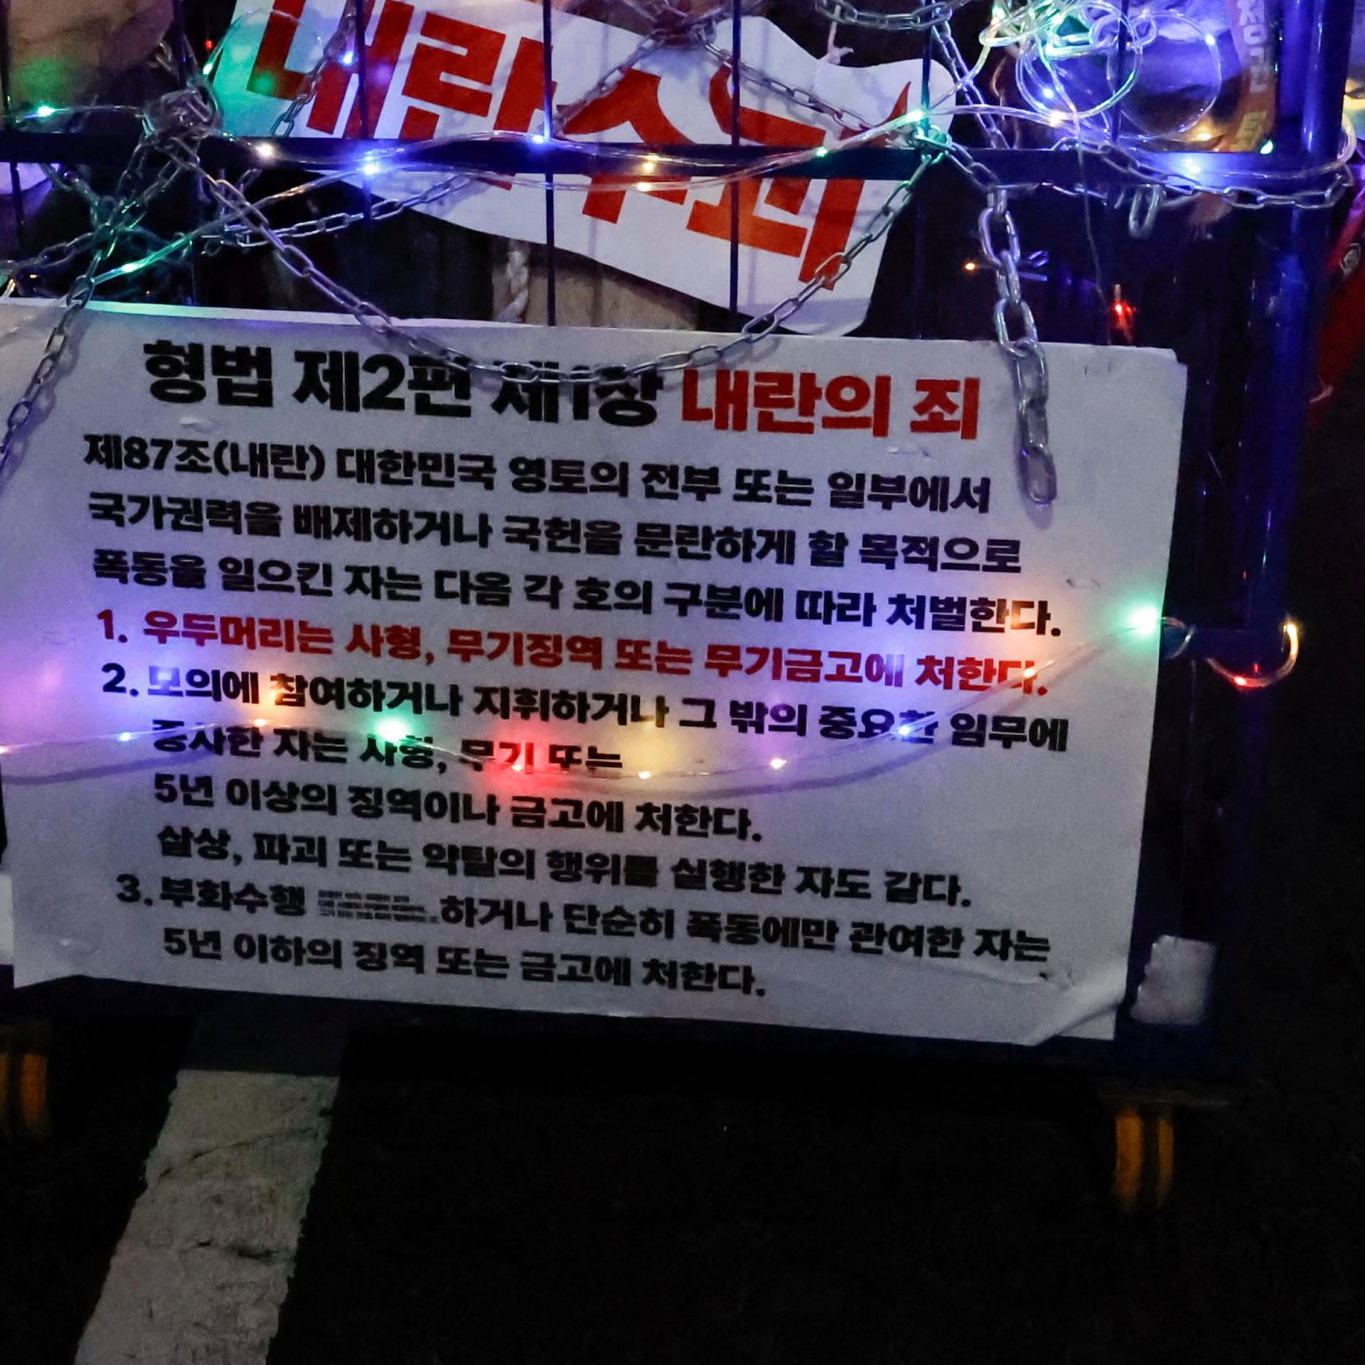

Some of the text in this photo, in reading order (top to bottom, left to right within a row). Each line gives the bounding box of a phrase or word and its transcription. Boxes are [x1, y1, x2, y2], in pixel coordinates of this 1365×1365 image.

[144, 340, 979, 439] 형법 제2편 제1장 내란의 죄
[84, 434, 990, 513] 제87조(내란) 대한민국 영토의 전부 또는 일부에서
[89, 492, 1021, 573] 국가권력을 배제하거나 국헌을 문란하게 할 목적으로
[93, 549, 1061, 636] 폭동을 일으킨 자는 다음 각 호의 구분에 따라 처벌한다.
[97, 609, 1047, 696] 1. 우두머리는 사형, 무기징역 또는 무기금고에 처한다.
[102, 663, 1068, 752] 2. 모의에 참여하거나 지휘하거나 그 밖의 중요한 임무에
[273, 729, 348, 764] 자는
[359, 734, 447, 774] 사형,
[459, 739, 534, 772] 무기
[548, 744, 623, 772] 또는
[155, 773, 762, 842] 5년 이상의 징역이나 금고에 처한다.
[157, 825, 242, 865] 살상,
[253, 833, 327, 867] 파괴
[339, 839, 411, 872] 또는
[423, 844, 535, 880] 약탈의
[546, 850, 659, 888] 행위를
[671, 858, 785, 895] 실행한
[795, 866, 871, 899] 자도
[117, 874, 153, 906] 3.
[160, 877, 305, 916] 부화수행
[440, 896, 553, 932] 하거나
[564, 904, 674, 939] 단순히
[687, 911, 839, 951] 폭동에만
[849, 922, 964, 958] 관여한
[974, 929, 1050, 962] 자는
[164, 928, 765, 997] 5년 이하의 징역 또는 금고에 처한다.
